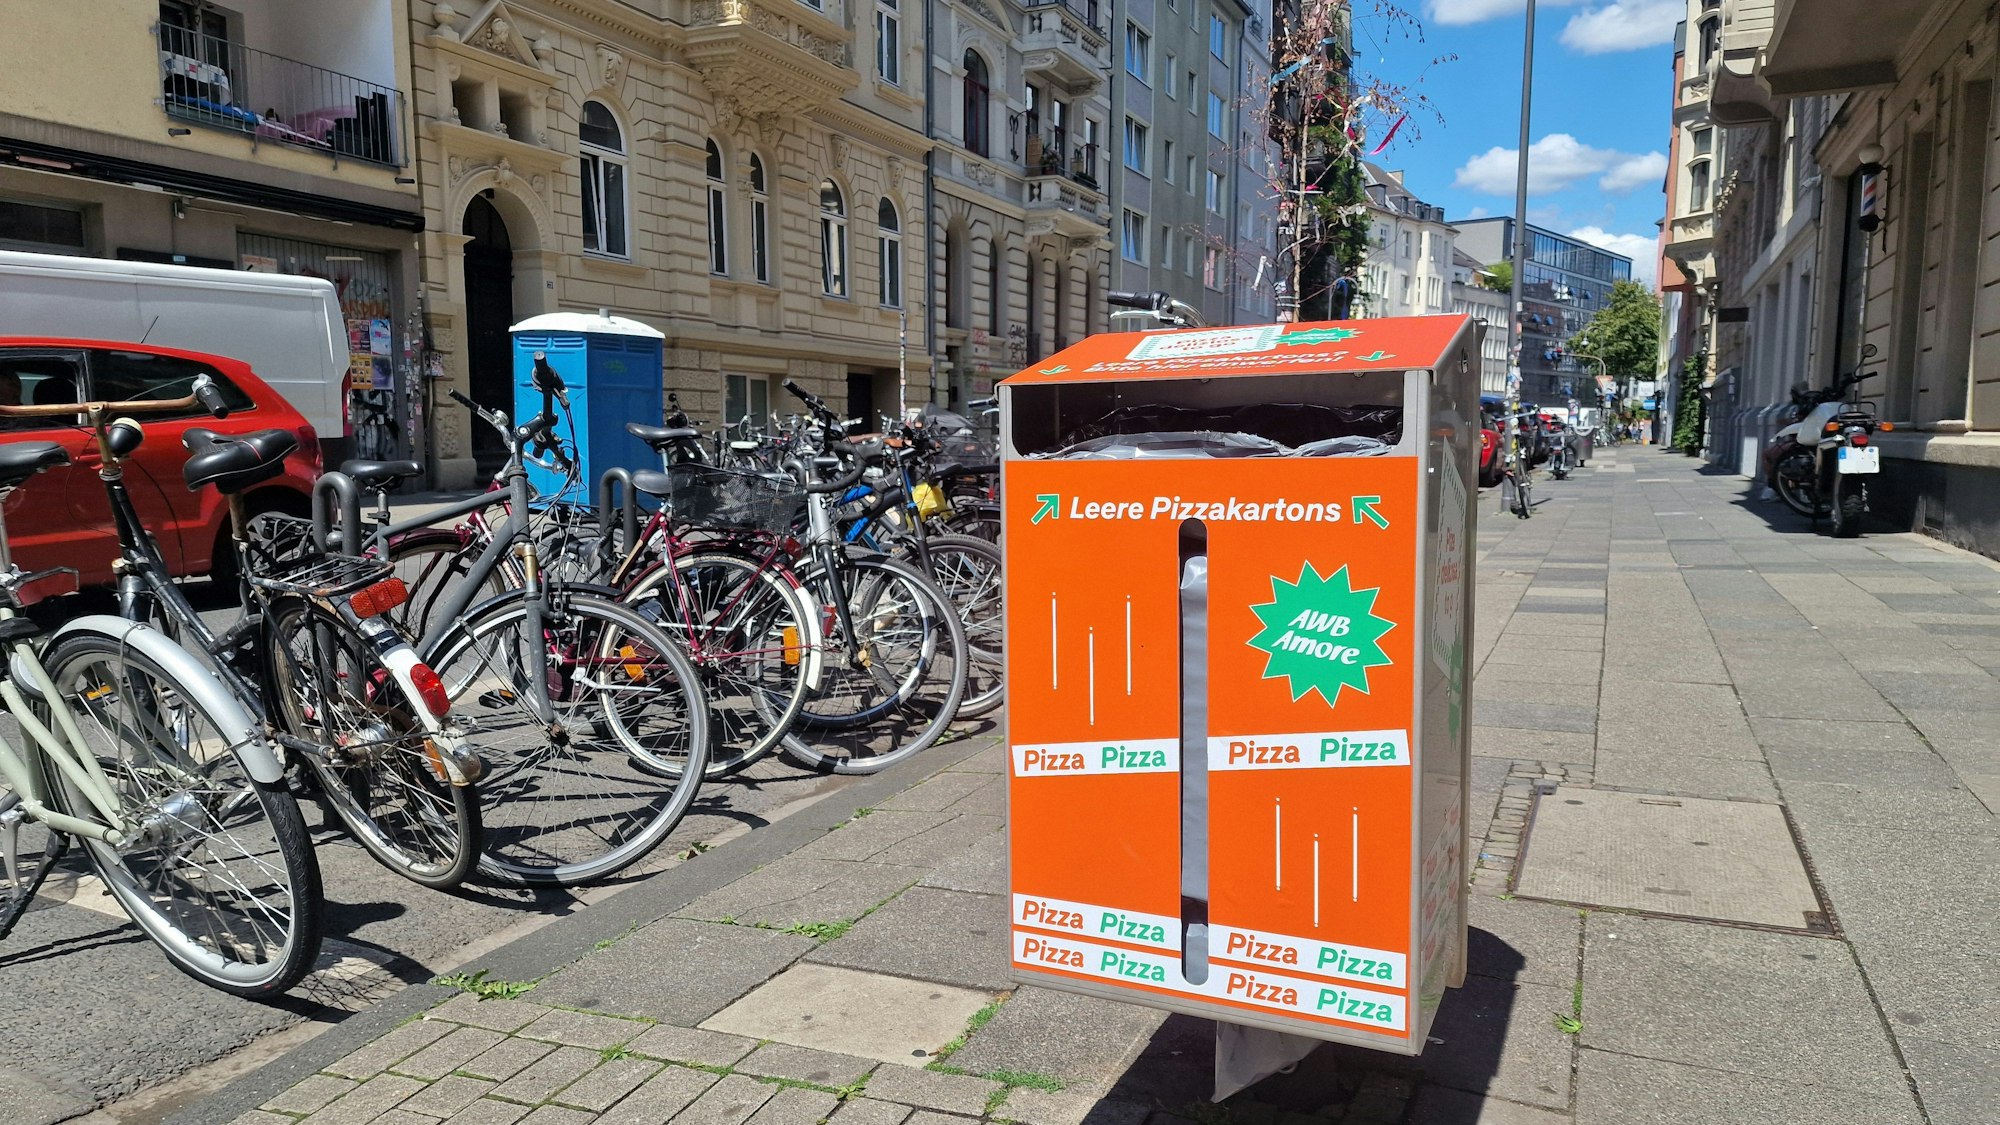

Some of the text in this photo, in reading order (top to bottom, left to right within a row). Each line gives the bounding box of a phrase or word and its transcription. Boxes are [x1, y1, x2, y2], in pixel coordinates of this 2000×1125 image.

[1070, 496, 1341, 522] Leere Pizzakartons
[1288, 609, 1350, 636] AWB
[1271, 630, 1360, 665] Amore
[1024, 737, 1396, 771] Pizza Pizza Pizza Pizza
[1022, 900, 1392, 980] Pizza Pizza Pizza Pizza
[1023, 938, 1392, 1022] Pizza Pizza Pizza Pizza
